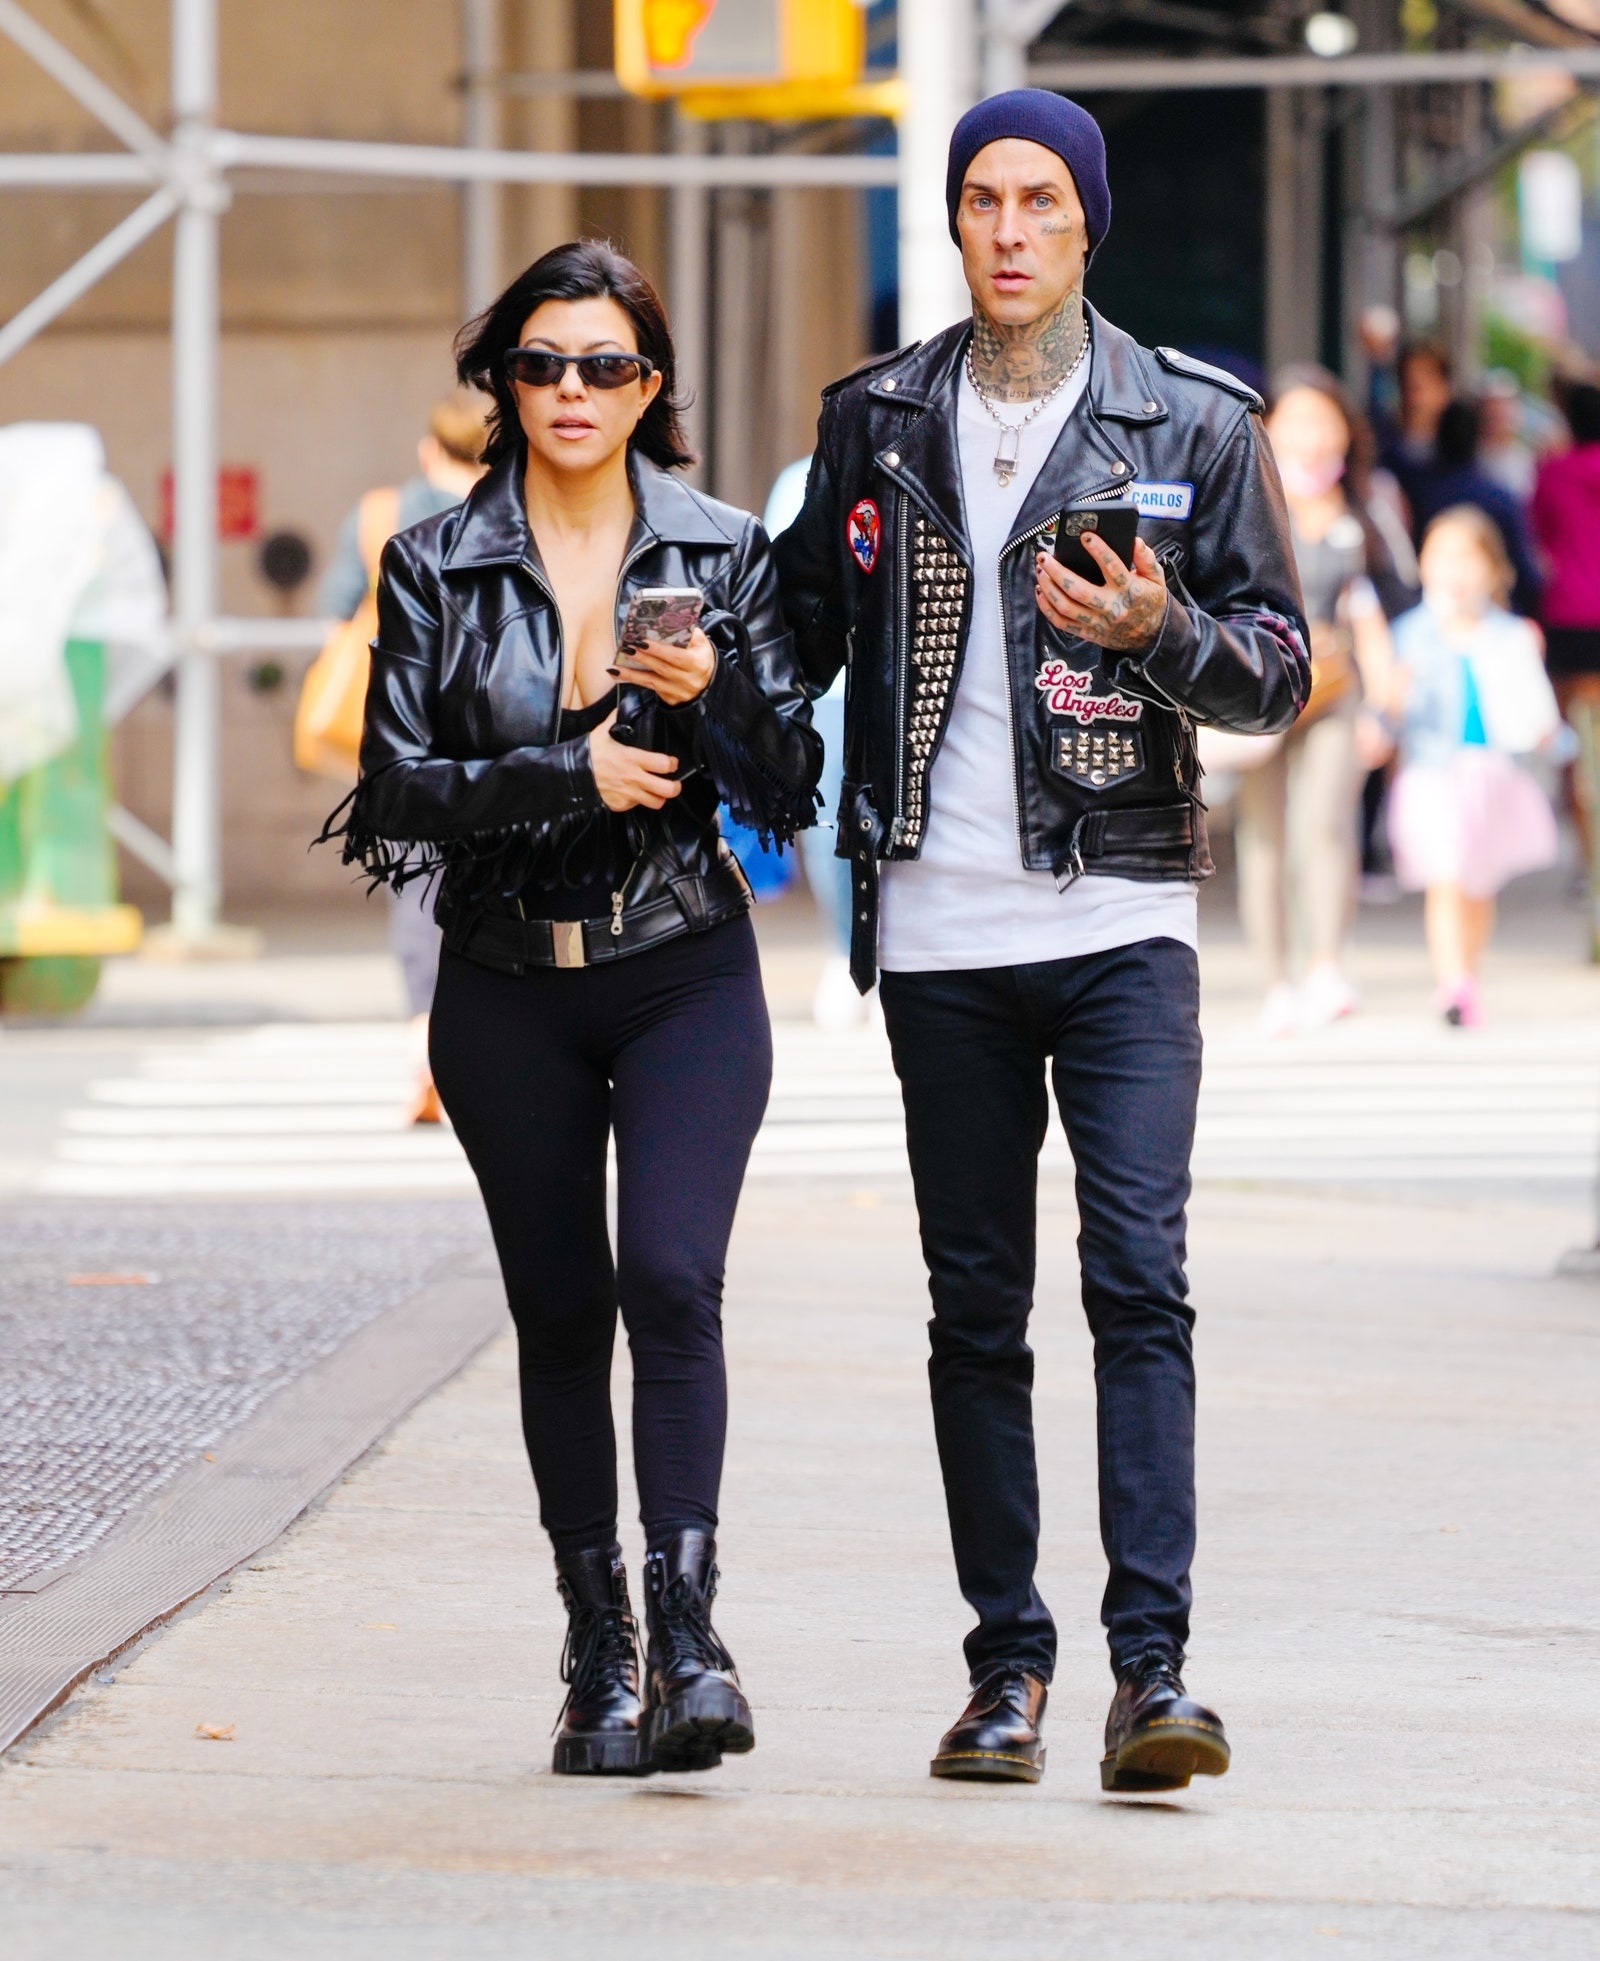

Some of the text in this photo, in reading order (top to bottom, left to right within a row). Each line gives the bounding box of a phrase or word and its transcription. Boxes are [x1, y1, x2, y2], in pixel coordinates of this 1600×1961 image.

[1132, 491, 1183, 508] CARLOS
[1039, 664, 1088, 688] Los
[1052, 688, 1139, 721] Angeles
